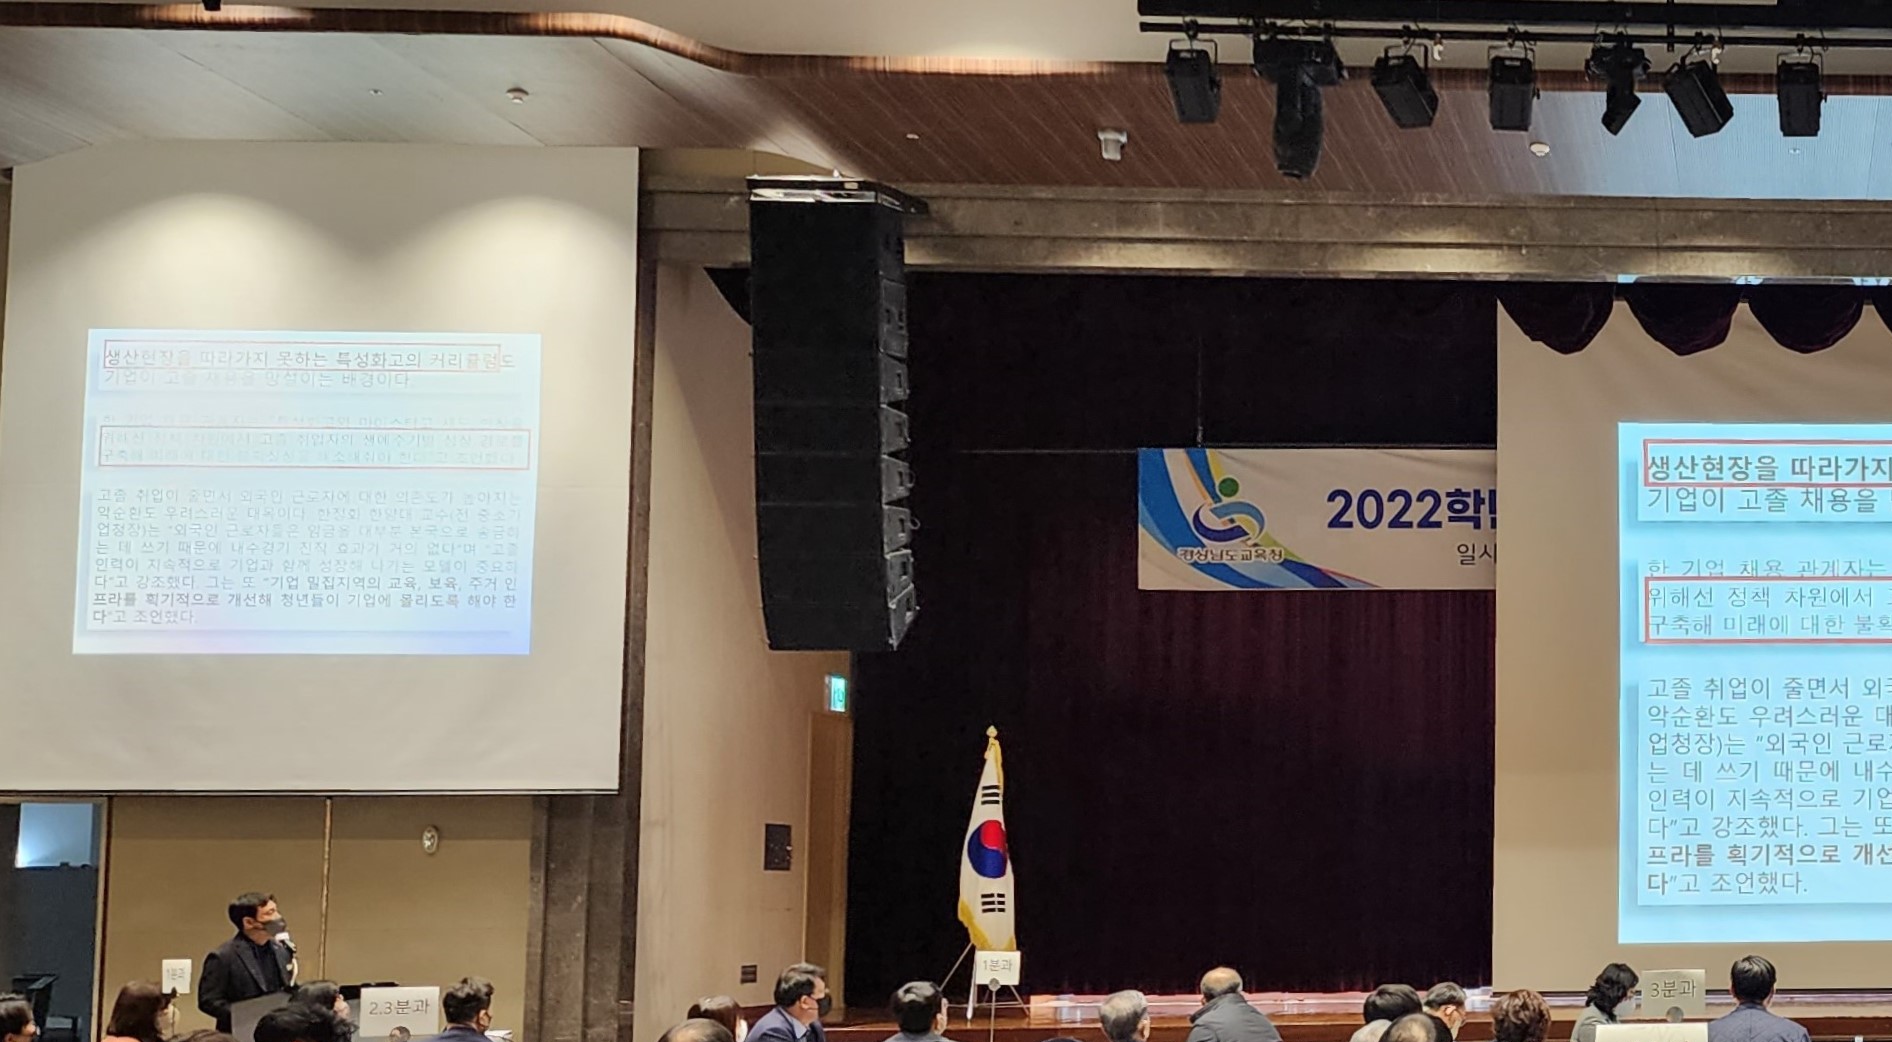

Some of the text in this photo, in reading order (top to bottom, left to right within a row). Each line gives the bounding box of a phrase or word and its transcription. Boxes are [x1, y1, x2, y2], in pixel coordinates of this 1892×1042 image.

[274, 351, 327, 368] 못하는
[1648, 455, 1779, 480] 생산현장을
[1791, 455, 1892, 480] 따라가지
[1327, 488, 1497, 530] 2022학
[1648, 488, 1724, 514] 기업이
[1737, 488, 1788, 514] 고졸
[1800, 488, 1878, 514] 채용을
[1180, 548, 1284, 561] 경상남도교육청
[1648, 676, 1692, 699] 고졸
[1704, 676, 1769, 699] 취업이
[1783, 676, 1848, 699] 줄면서
[1648, 704, 1738, 728] 악순환도
[1749, 704, 1864, 728] 우려스러운
[1648, 732, 1746, 756] 업청장)는
[1647, 759, 1669, 782] 는
[1683, 759, 1702, 782] 데
[1716, 759, 1758, 782] 쓰기
[1774, 759, 1839, 782] 때문에
[1649, 787, 1714, 810] 인력이
[1727, 787, 1841, 810] 지속적으로
[1712, 814, 1808, 838] 강조했다.
[1817, 814, 1862, 838] 그는
[1647, 842, 1715, 866] 프라를
[1727, 842, 1841, 866] 획기적으로
[1711, 871, 1807, 895] 조언했다.
[983, 958, 1013, 972] 1분과
[1650, 979, 1697, 998] 3분과
